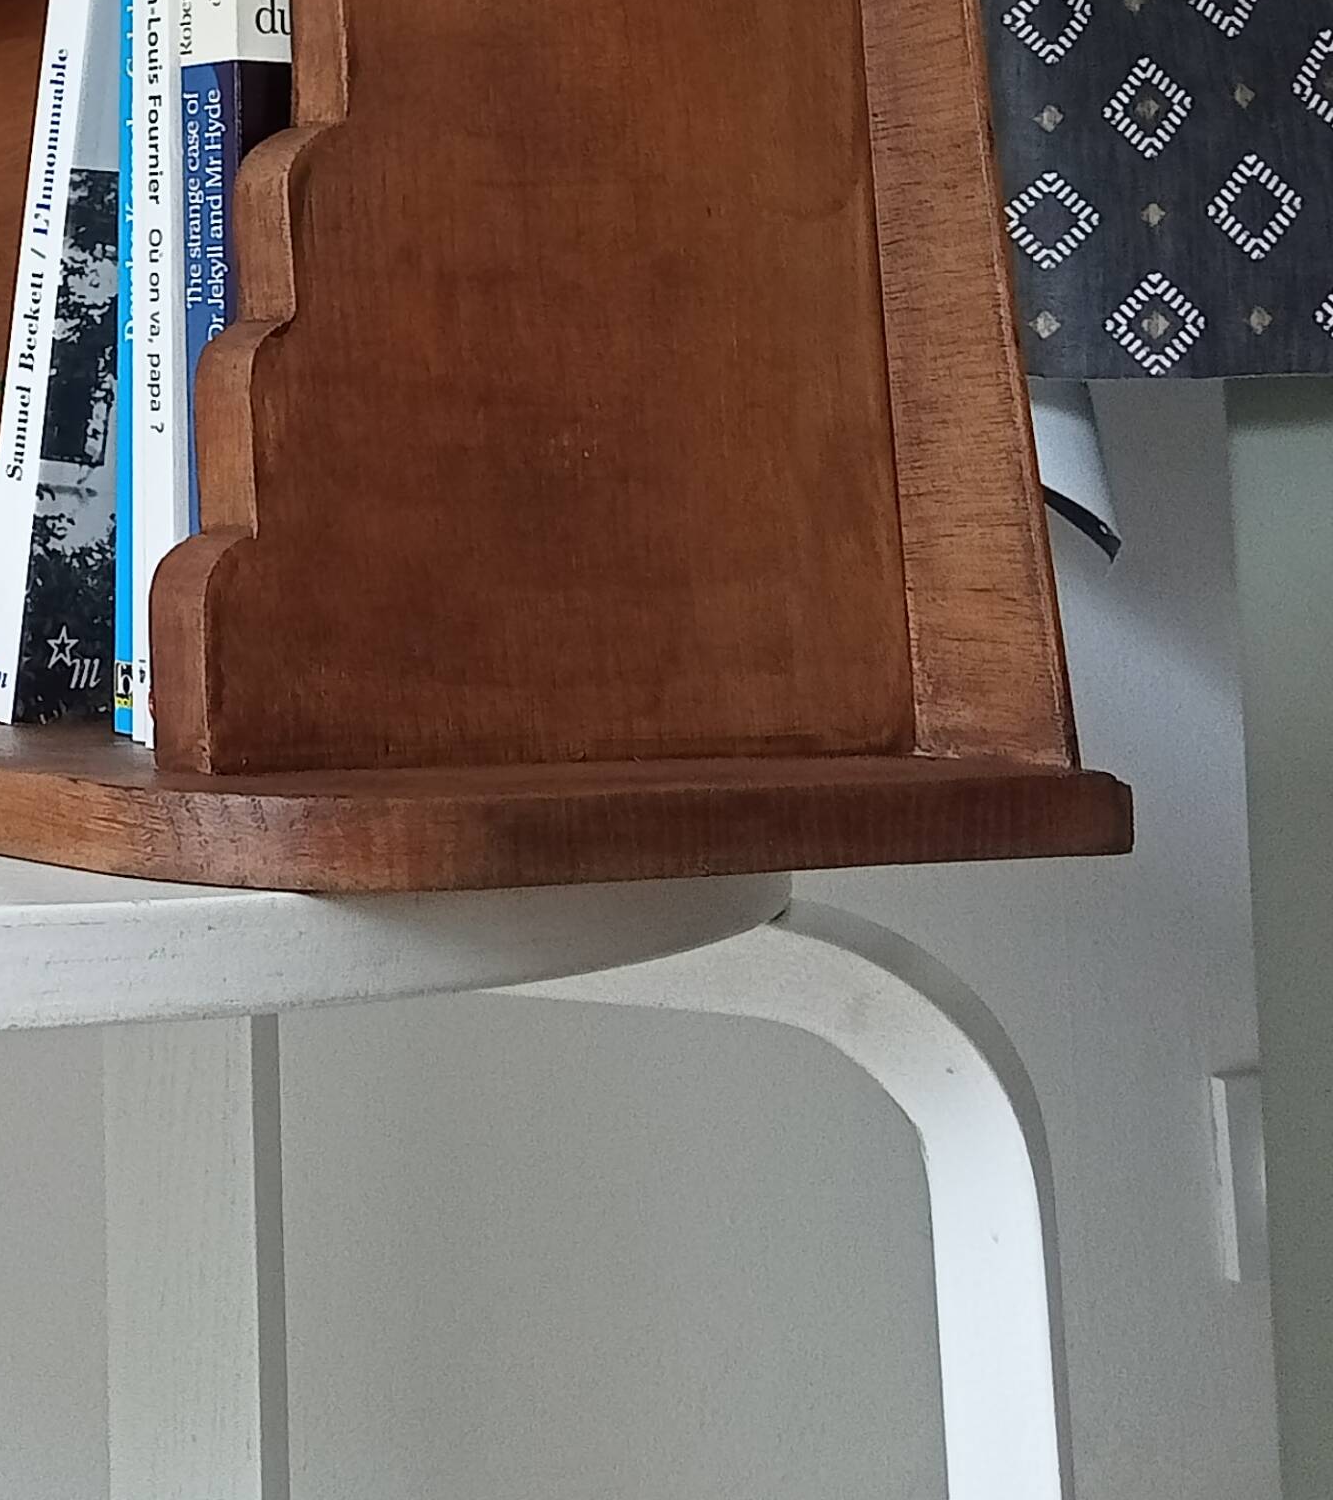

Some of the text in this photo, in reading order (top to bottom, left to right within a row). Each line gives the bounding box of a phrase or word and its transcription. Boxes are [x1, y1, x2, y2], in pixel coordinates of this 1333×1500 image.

[32, 49, 69, 236] L'Innommable
[147, 94, 165, 205] Fournier
[203, 88, 227, 151] Hyde
[182, 92, 205, 309] The strange case of
[204, 155, 223, 188] Mr
[147, 228, 164, 264] Où
[205, 194, 224, 239] and
[148, 272, 161, 303] on
[205, 245, 229, 310] Jekyll
[18, 270, 45, 373] Beckett
[147, 310, 162, 344] va,
[146, 353, 162, 413] papa
[6, 385, 32, 481] Samuel
